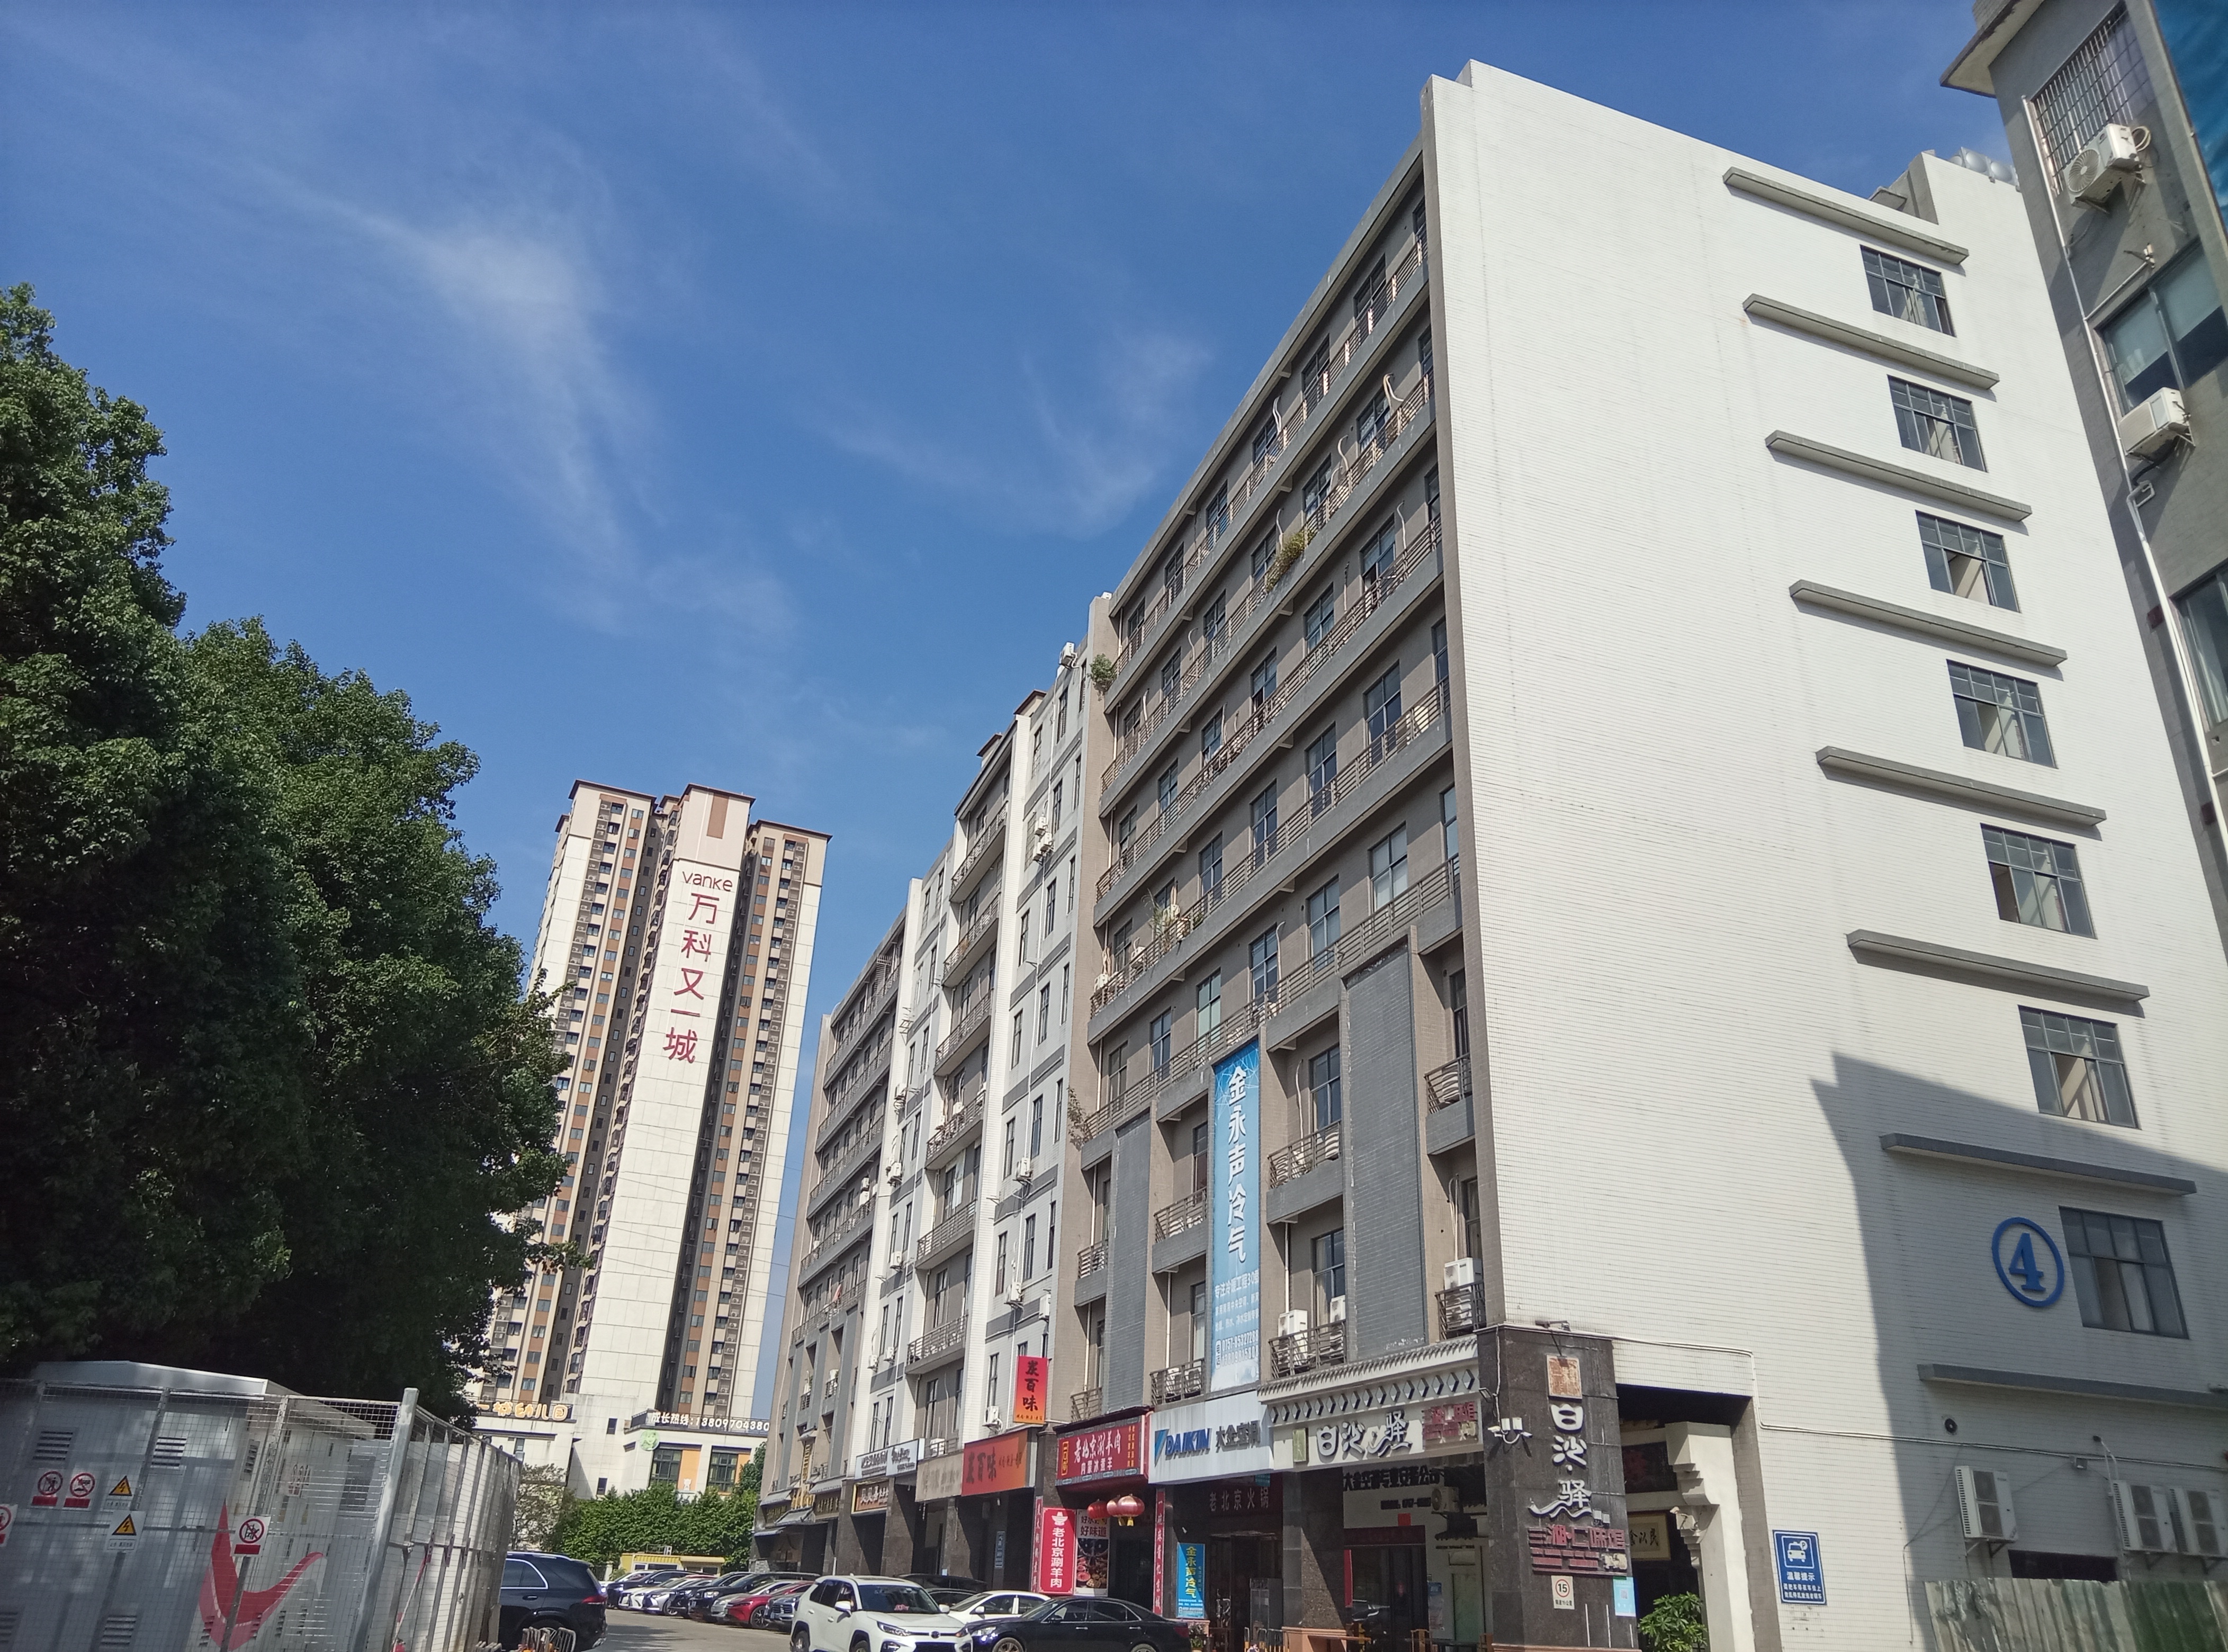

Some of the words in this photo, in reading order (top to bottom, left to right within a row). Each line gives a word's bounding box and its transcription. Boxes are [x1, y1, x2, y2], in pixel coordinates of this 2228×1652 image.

[682, 871, 733, 892] vanke
[662, 893, 720, 1064] 万科又一城
[1227, 1065, 1247, 1262] 金永声冷气
[2009, 1232, 2047, 1293] 4
[1022, 1360, 1039, 1412] 炭百味
[1165, 1428, 1211, 1457] DAIKIN
[1209, 1487, 1269, 1511] 老北京火锅
[1081, 1525, 1107, 1537] 好味道
[1050, 1528, 1065, 1588] 老北京涮羊肉
[1185, 1546, 1197, 1599] 金永声冷气
[1787, 1572, 1815, 1582] 温馨提示
[1558, 1583, 1567, 1593] 15
